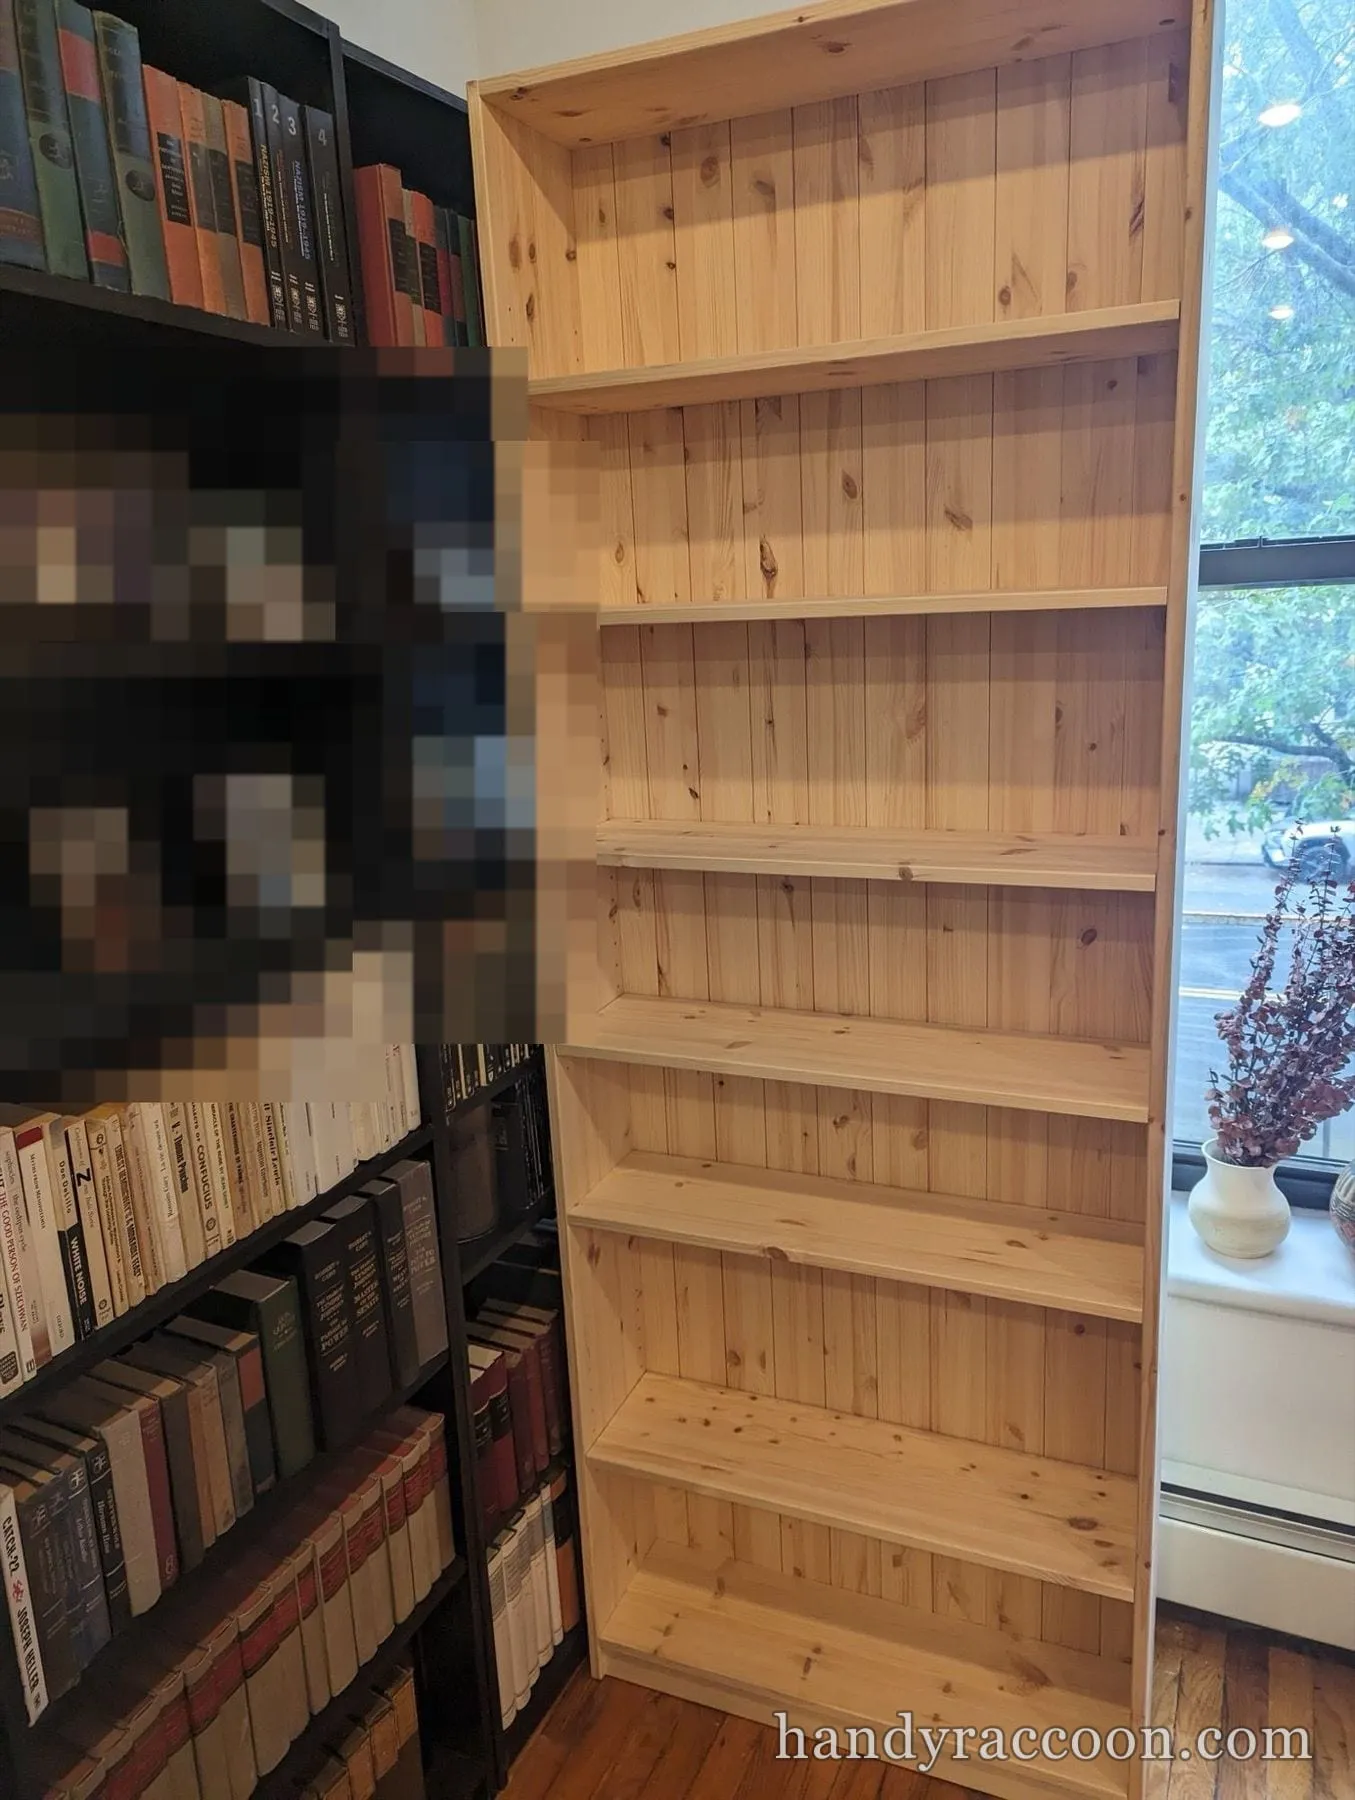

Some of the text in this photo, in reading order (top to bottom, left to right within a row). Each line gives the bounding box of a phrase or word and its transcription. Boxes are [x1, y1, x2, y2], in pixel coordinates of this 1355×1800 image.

[253, 99, 262, 117] 1
[272, 104, 279, 123] 2
[288, 117, 296, 135] 3
[318, 128, 327, 146] 4
[261, 144, 270, 185] NAZISM
[295, 160, 304, 201] NAZISM
[173, 1135, 186, 1163] Thomas
[265, 1115, 277, 1157] Sinclair
[272, 1157, 282, 1186] Lewis
[59, 1161, 73, 1214] Don DeLillo
[197, 1144, 212, 1210] CONFUCIUS
[0, 1192, 8, 1209] THE
[2, 1210, 13, 1239] GOOD
[7, 1239, 18, 1272] PERSON
[18, 1234, 26, 1253] cycle
[70, 1237, 82, 1272] WHITE
[12, 1272, 21, 1284] OF
[132, 1258, 141, 1278] FEAST
[75, 1271, 88, 1305] NOISE
[15, 1285, 29, 1331] SZECHWAN
[320, 1324, 349, 1352] POWER
[3, 1516, 19, 1577] CATCH-22
[17, 1607, 39, 1693] JOSEPH HELLER
